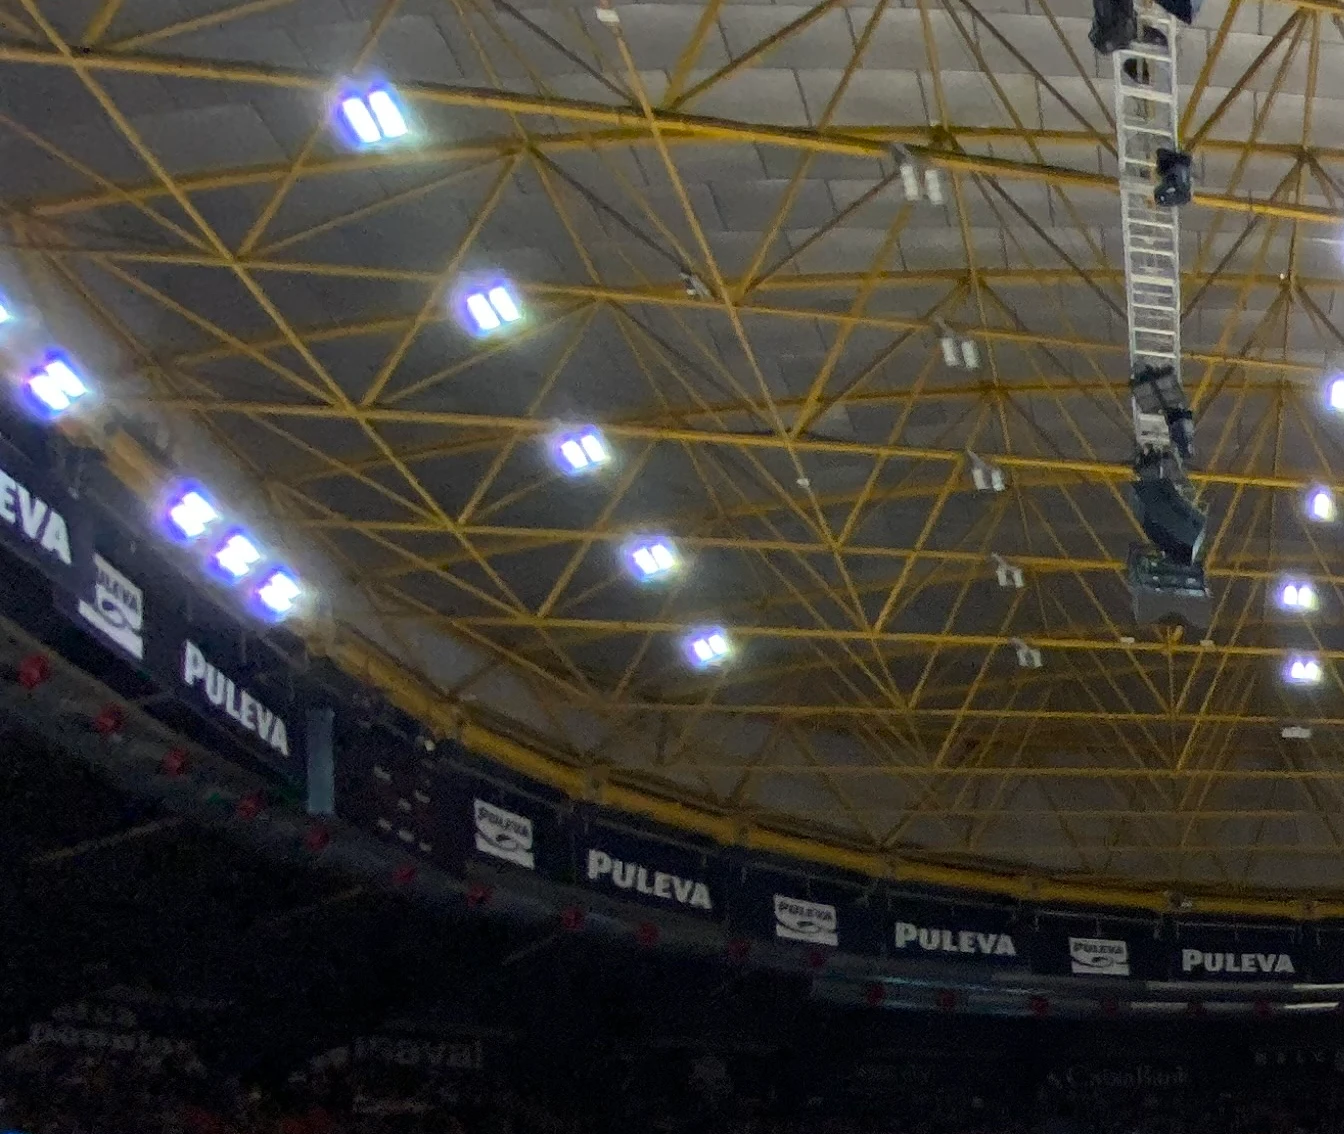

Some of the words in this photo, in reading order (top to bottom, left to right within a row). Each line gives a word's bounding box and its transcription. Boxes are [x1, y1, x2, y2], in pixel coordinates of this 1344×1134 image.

[184, 639, 289, 756] PULEVA
[588, 849, 712, 909] PULEVA
[895, 922, 1017, 957] PULEVA
[1181, 948, 1296, 974] PULEVA
